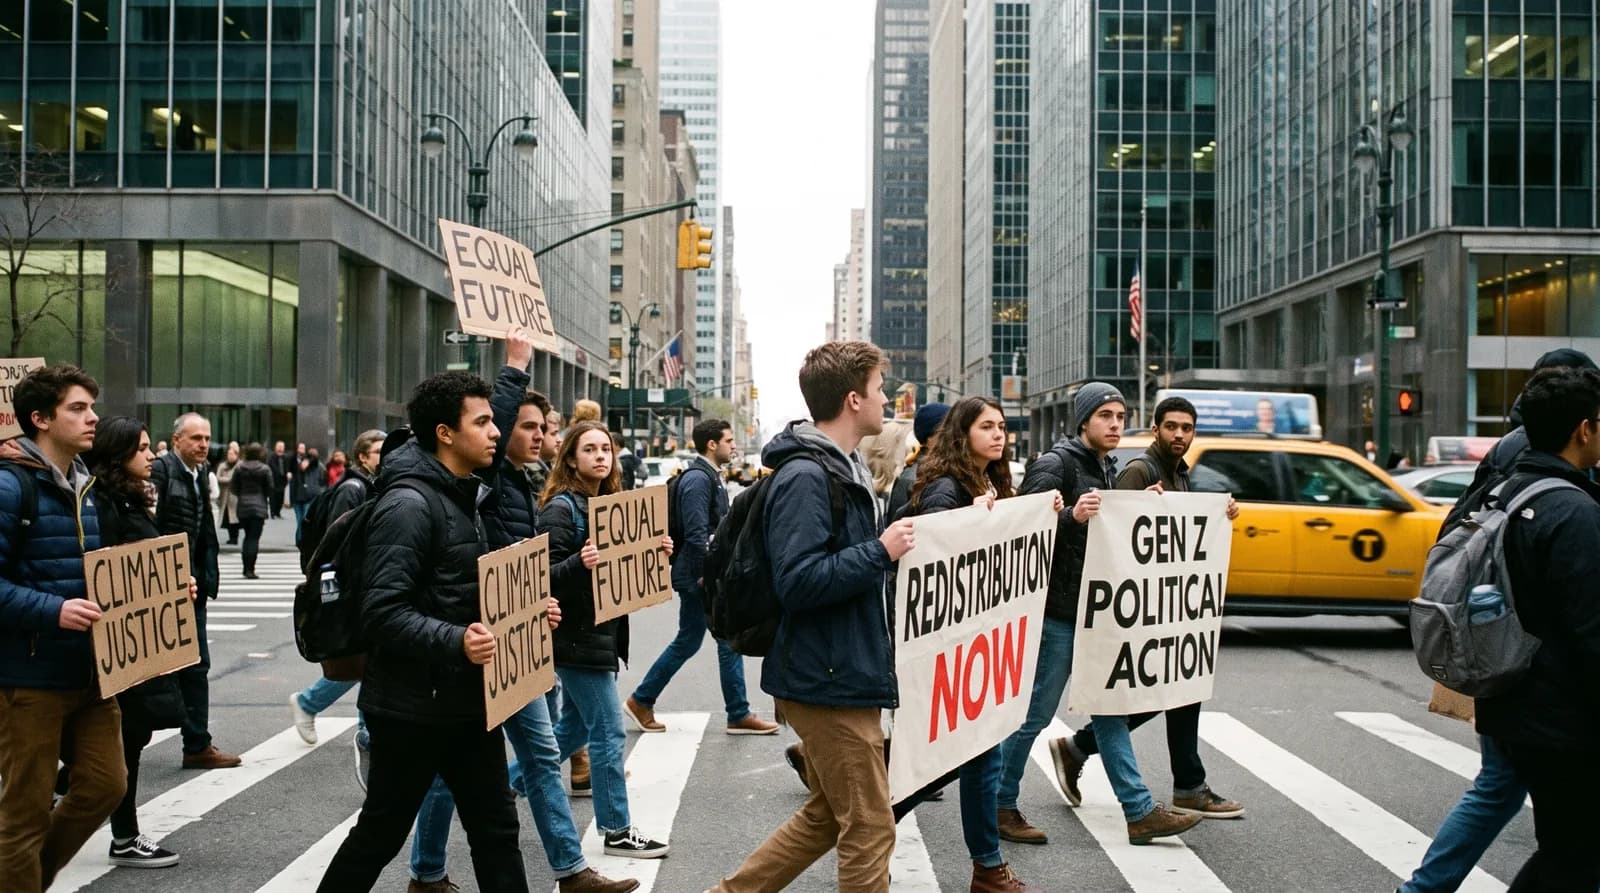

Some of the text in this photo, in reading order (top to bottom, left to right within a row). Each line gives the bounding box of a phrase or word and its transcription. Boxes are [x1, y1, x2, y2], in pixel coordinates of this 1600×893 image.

[451, 230, 541, 289] EQUAL
[459, 279, 553, 337] FUTURE
[594, 496, 665, 550] EQUAL
[1131, 515, 1208, 565] GEN Z
[93, 542, 189, 613] CLIMATE
[484, 547, 548, 626] CLIMATE
[596, 546, 668, 610] FUTURE
[904, 529, 1052, 642] REDISTRIBUTION
[101, 597, 192, 675] JUSTICE
[488, 611, 550, 699] JUSTICE
[1105, 630, 1215, 689] ACTION
[929, 616, 1028, 744] NOW
